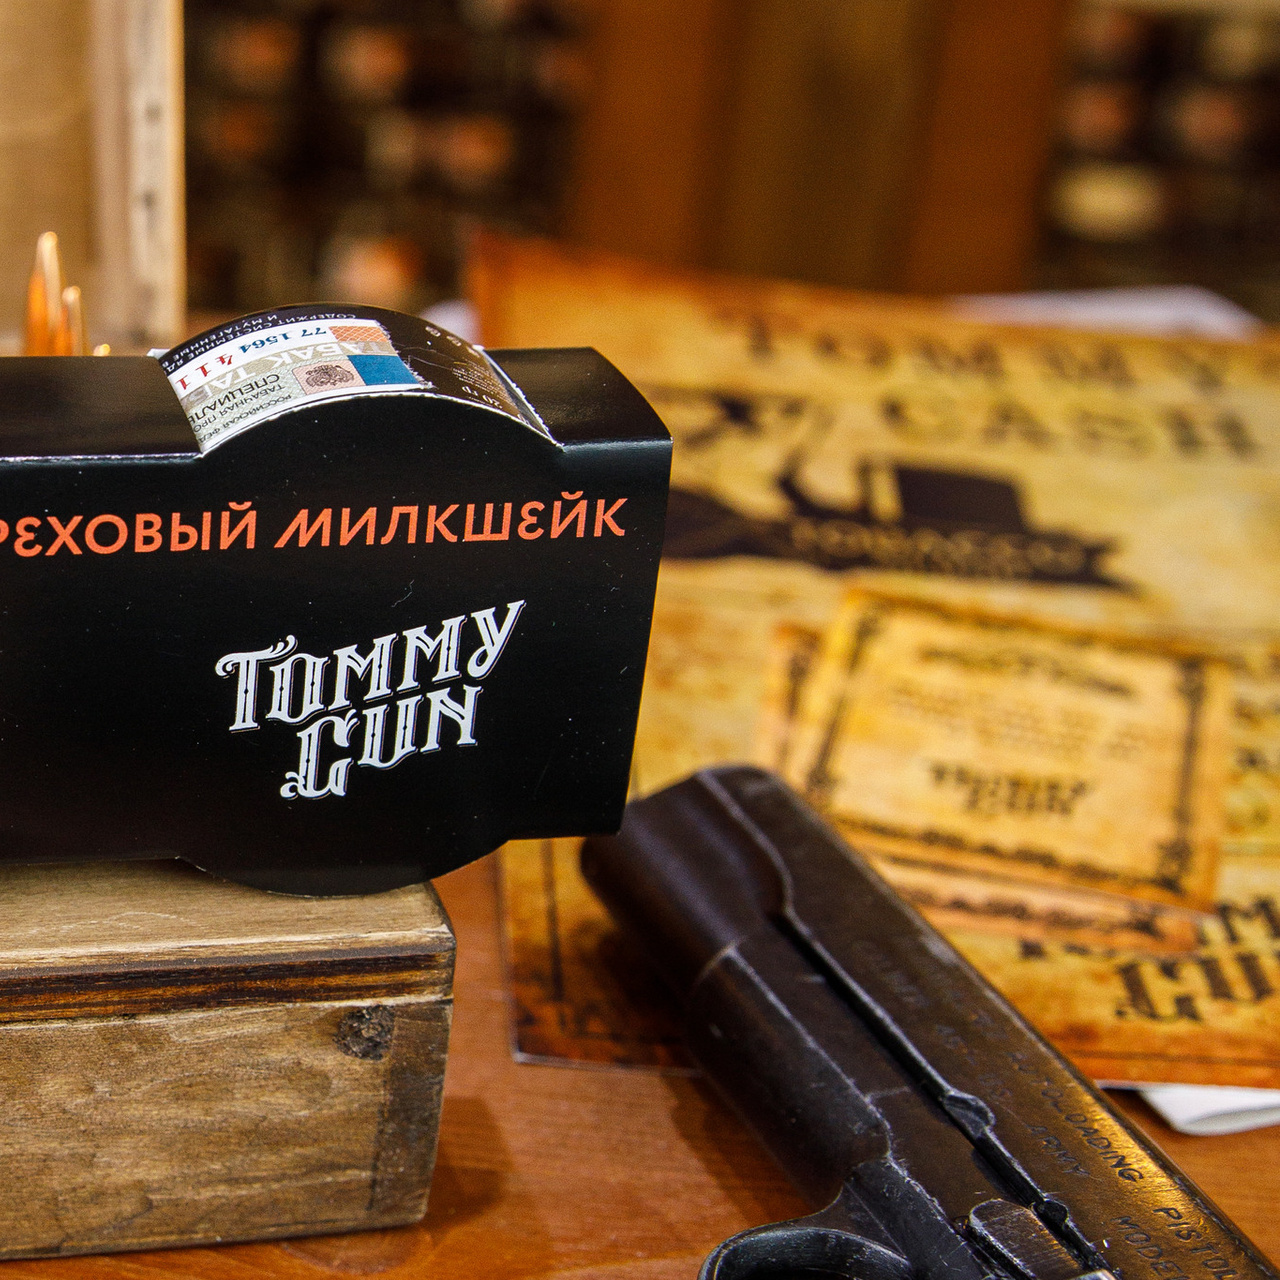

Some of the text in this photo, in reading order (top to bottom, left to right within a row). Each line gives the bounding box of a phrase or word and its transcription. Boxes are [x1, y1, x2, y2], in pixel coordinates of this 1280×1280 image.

[267, 313, 278, 321] И
[278, 313, 357, 326] СОДЕРЖИТ
[300, 327, 327, 338] 77
[172, 318, 263, 361] МУТАГЕННЫЕ
[188, 321, 272, 360] СИСТЕМНЫЕ
[239, 331, 293, 354] 1564
[265, 341, 390, 369] ТАБАК
[219, 382, 286, 417] ТАБАЧНАЯ
[222, 393, 293, 430] РОССИЙСКАЯ
[273, 490, 629, 549] МИЛКШЕЙК
[215, 600, 526, 732] TOMMY
[280, 685, 484, 799] GUN
